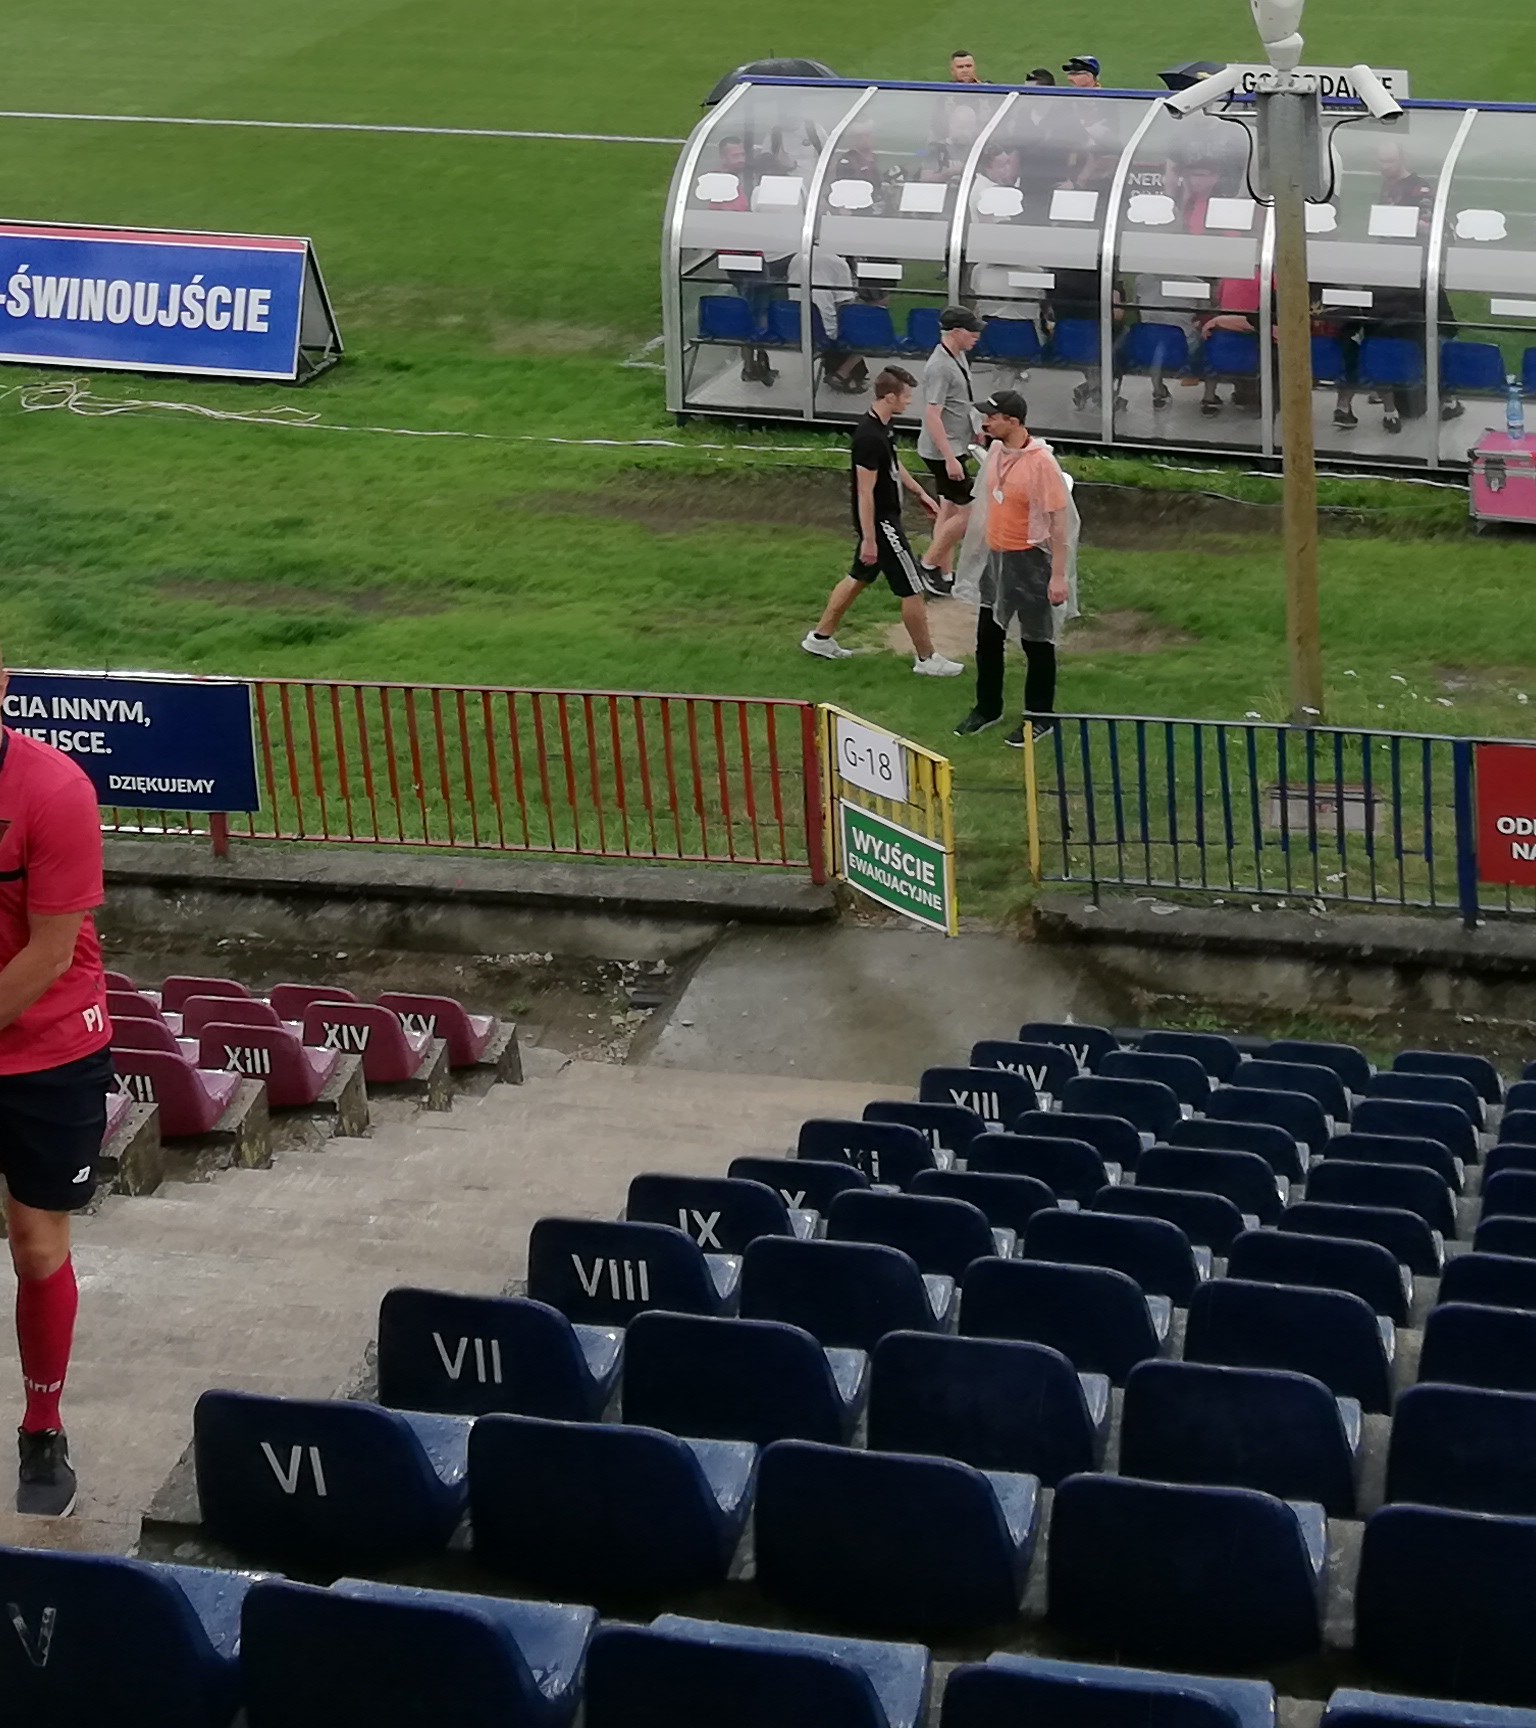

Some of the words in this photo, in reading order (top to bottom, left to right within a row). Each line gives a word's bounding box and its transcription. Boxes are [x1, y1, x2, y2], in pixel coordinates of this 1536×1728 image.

[51, 696, 151, 727] INNYM,
[843, 737, 893, 781] G-18
[108, 774, 215, 794] DZIĘKUJEMY
[851, 826, 936, 887] WYJŚCIE
[848, 854, 943, 912] EWAKUACYJNE
[322, 1020, 370, 1051] XIV
[223, 1043, 271, 1074] XIII
[113, 1072, 156, 1102] XII
[949, 1088, 1001, 1120] XIII
[678, 1207, 723, 1249] IX
[570, 1253, 650, 1302] VIII
[431, 1331, 504, 1384] VII
[259, 1440, 328, 1497] VI
[5, 1601, 57, 1668] V
